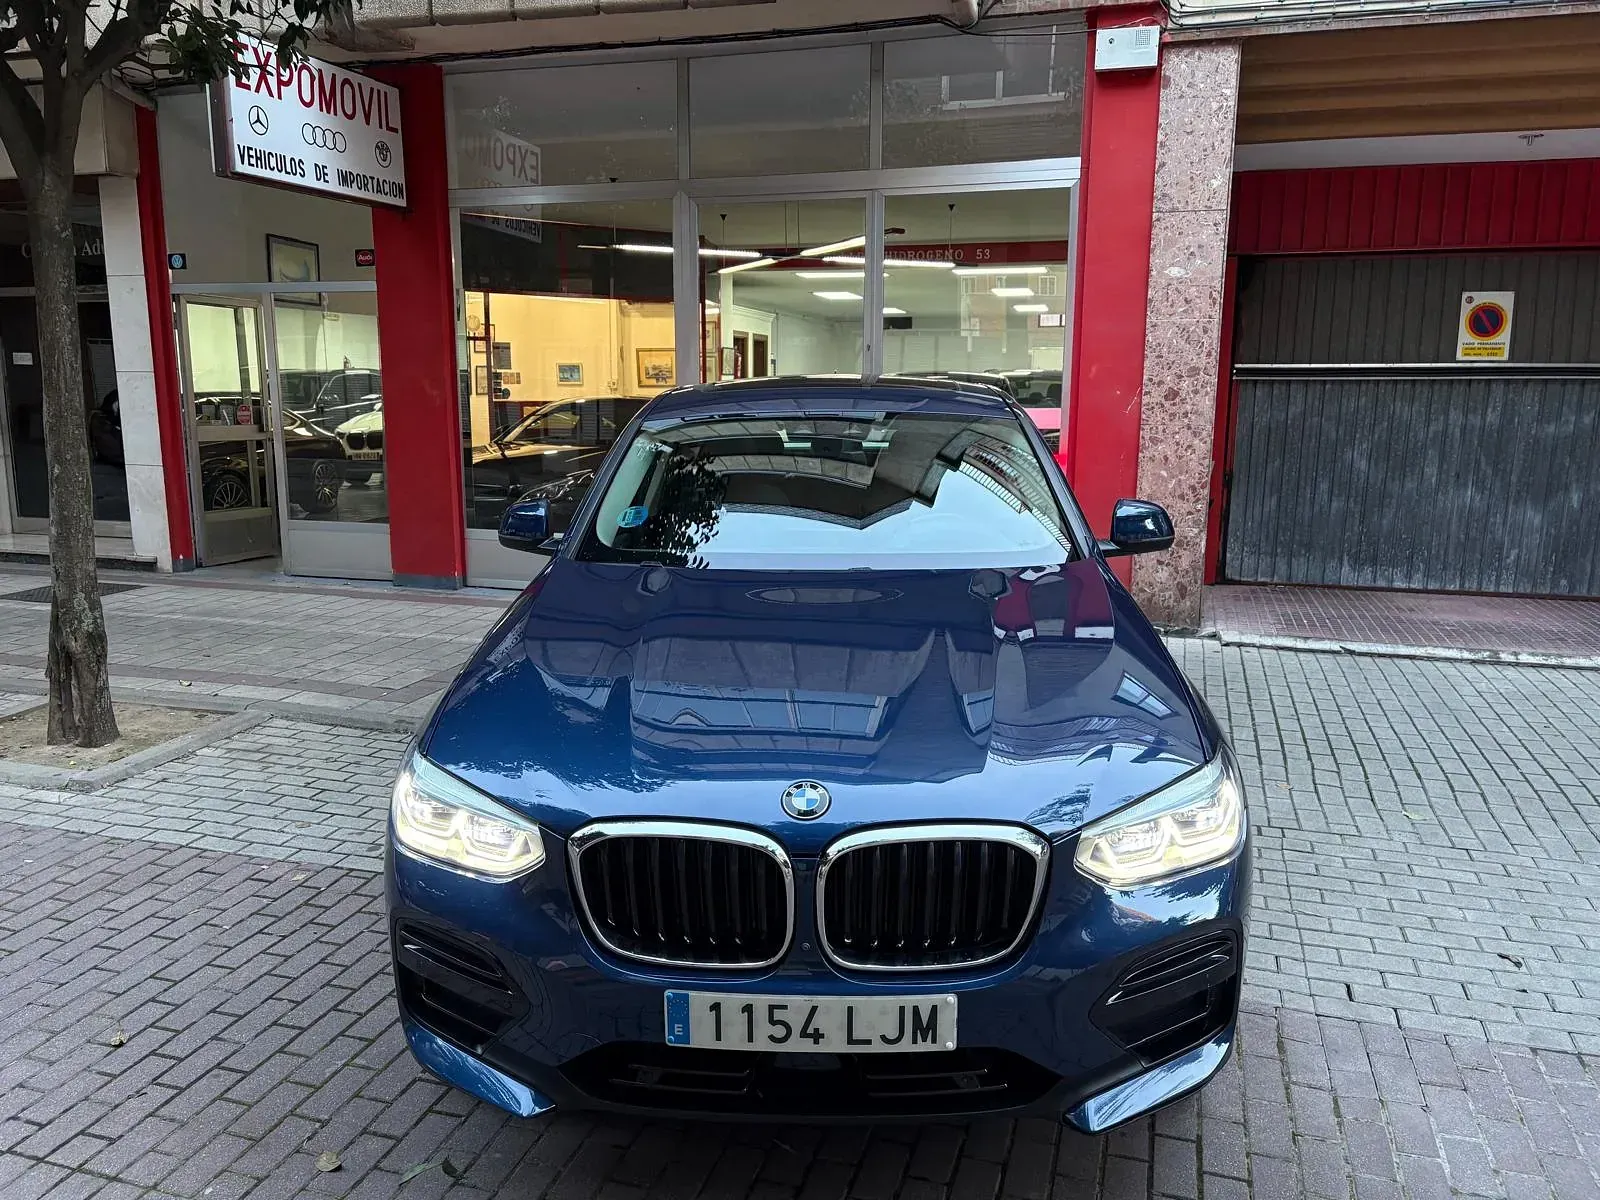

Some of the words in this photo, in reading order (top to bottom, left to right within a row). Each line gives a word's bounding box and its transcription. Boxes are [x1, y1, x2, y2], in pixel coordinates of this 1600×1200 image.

[233, 37, 399, 134] EXPOMOVIL
[236, 143, 306, 178] VEHICULOS
[314, 162, 330, 184] DE
[336, 168, 405, 200] IMPORTACION
[975, 248, 991, 260] 53
[674, 1024, 683, 1035] E
[708, 1001, 825, 1045] 1154
[846, 1004, 938, 1046] LJM
